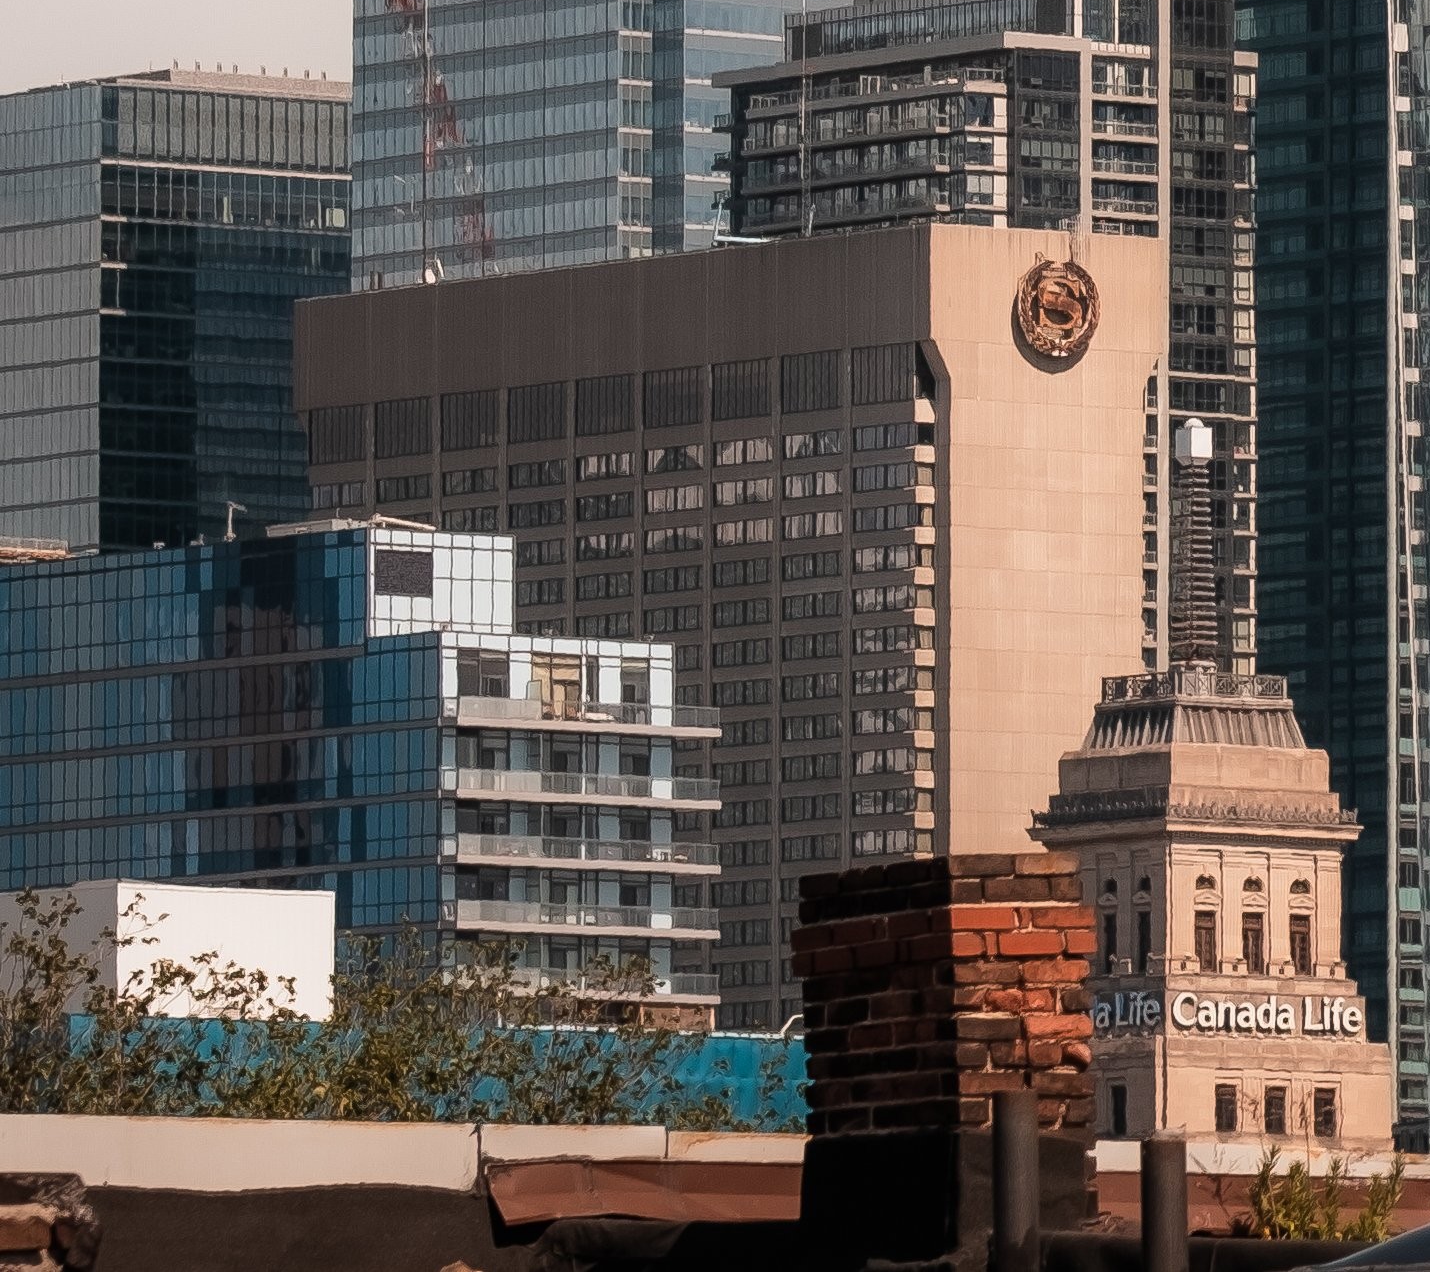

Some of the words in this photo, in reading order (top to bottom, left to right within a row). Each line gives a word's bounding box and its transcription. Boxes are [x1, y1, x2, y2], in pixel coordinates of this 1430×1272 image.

[1114, 991, 1161, 1028] Life
[1172, 992, 1295, 1032] Canada
[1302, 995, 1364, 1034] Life
